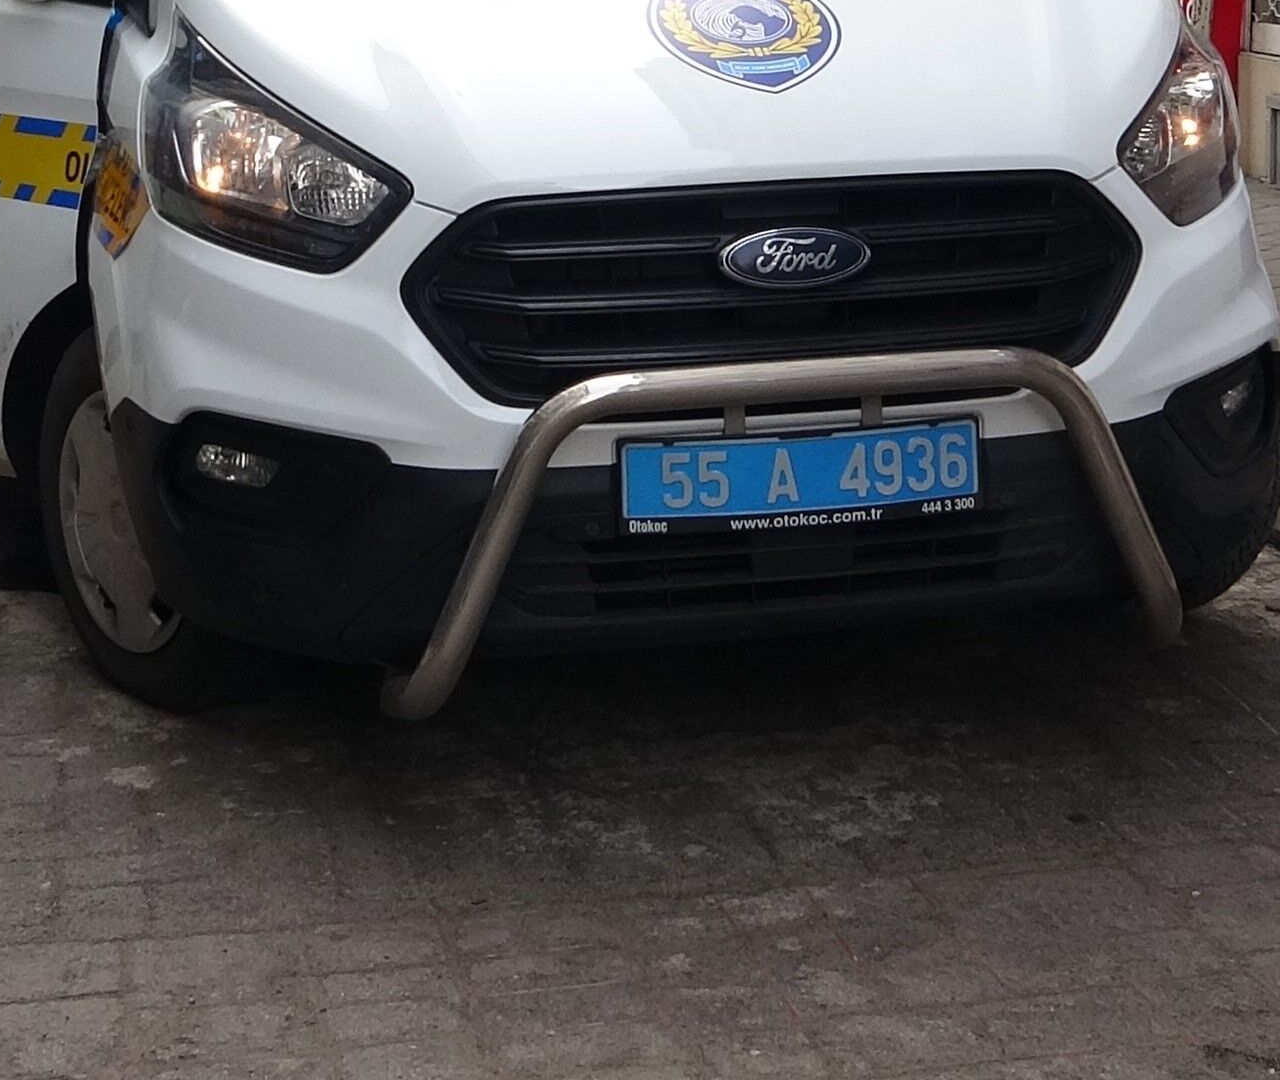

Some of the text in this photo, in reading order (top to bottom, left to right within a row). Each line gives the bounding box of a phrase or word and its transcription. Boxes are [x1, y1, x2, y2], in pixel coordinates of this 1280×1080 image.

[756, 237, 836, 273] Ford
[661, 433, 968, 510] 55 A 4936
[730, 507, 883, 531] www.otokoc.com.tr
[921, 500, 942, 514] 444
[945, 499, 953, 511] 3
[955, 497, 975, 510] 300
